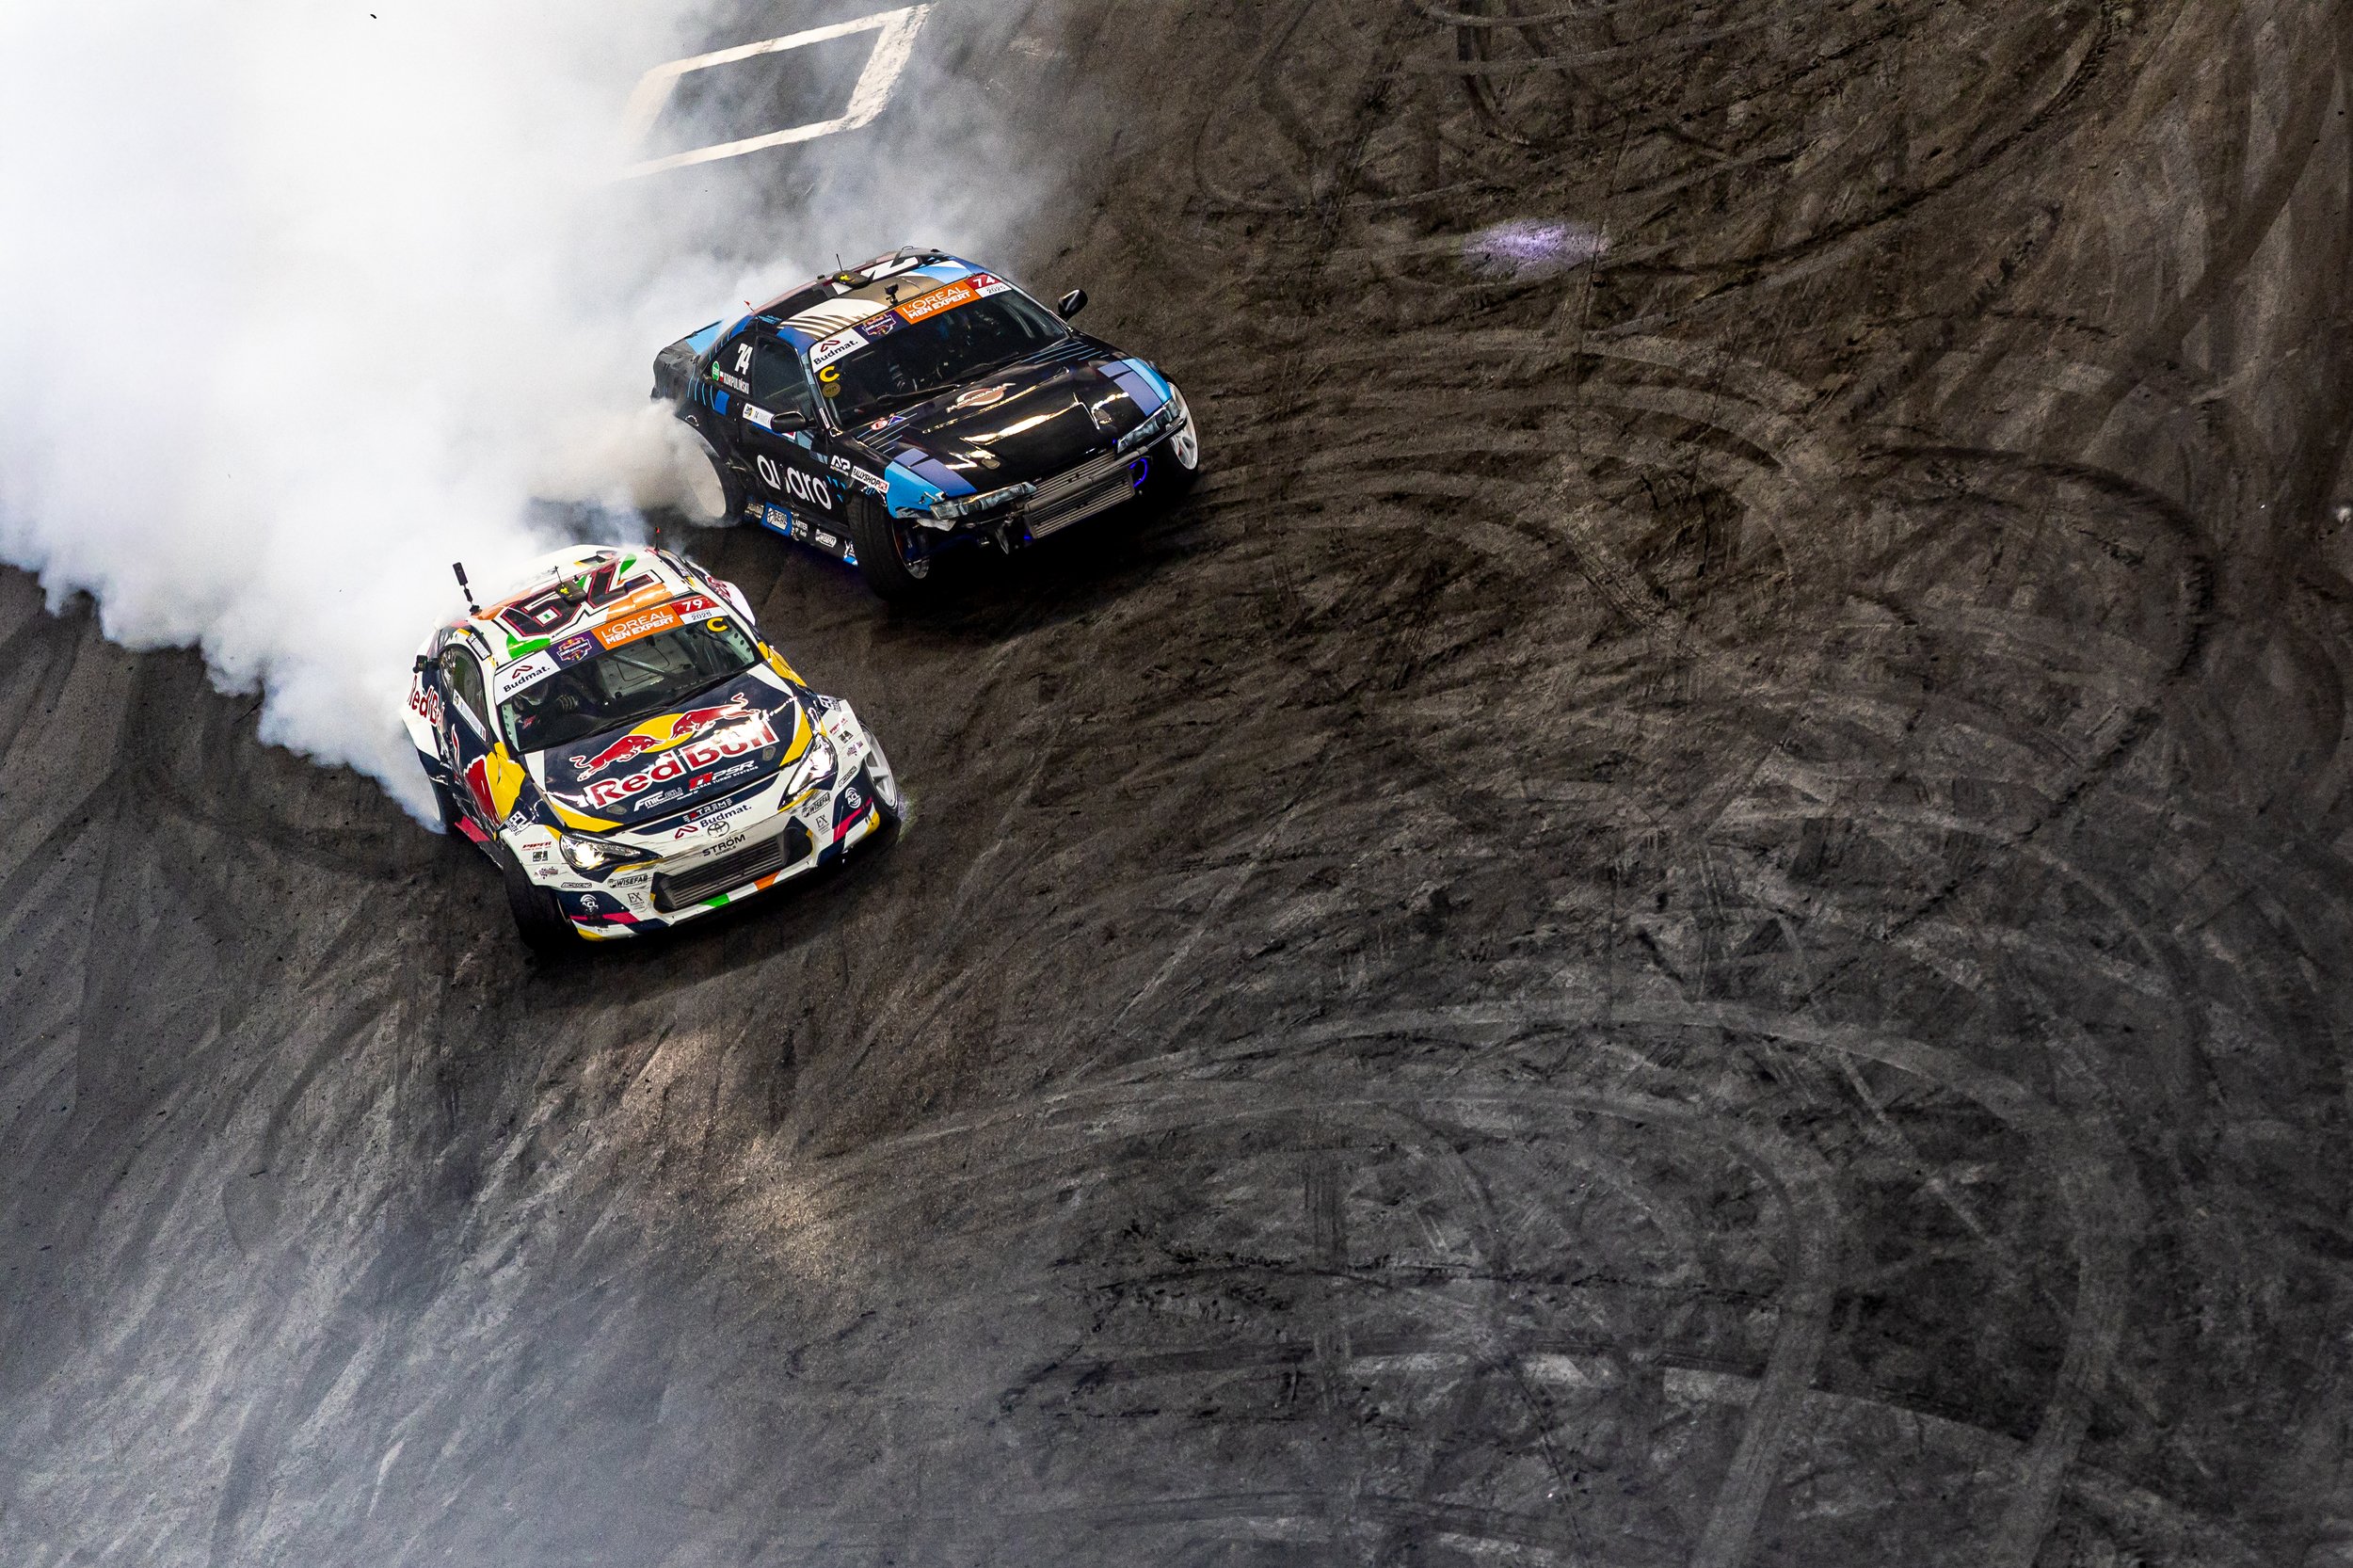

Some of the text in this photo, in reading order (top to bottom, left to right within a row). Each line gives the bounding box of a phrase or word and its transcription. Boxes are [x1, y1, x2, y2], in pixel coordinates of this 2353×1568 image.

[972, 275, 996, 288] 74
[903, 286, 968, 314] L'ORÉAL
[907, 291, 970, 319] MEN EXPERT
[734, 343, 753, 376] 74
[813, 340, 858, 365] Budmat.
[819, 365, 840, 383] C
[681, 599, 703, 612] 79
[692, 611, 712, 621] 2025
[601, 611, 673, 638] L'ORÉAL
[605, 616, 674, 645] MEN EXPERT
[706, 617, 728, 632] C
[503, 666, 551, 693] Budmat.
[584, 749, 687, 809] Red
[712, 775, 732, 785] TURBO
[699, 804, 752, 828] Budmat.
[702, 834, 745, 857] STRÖM
